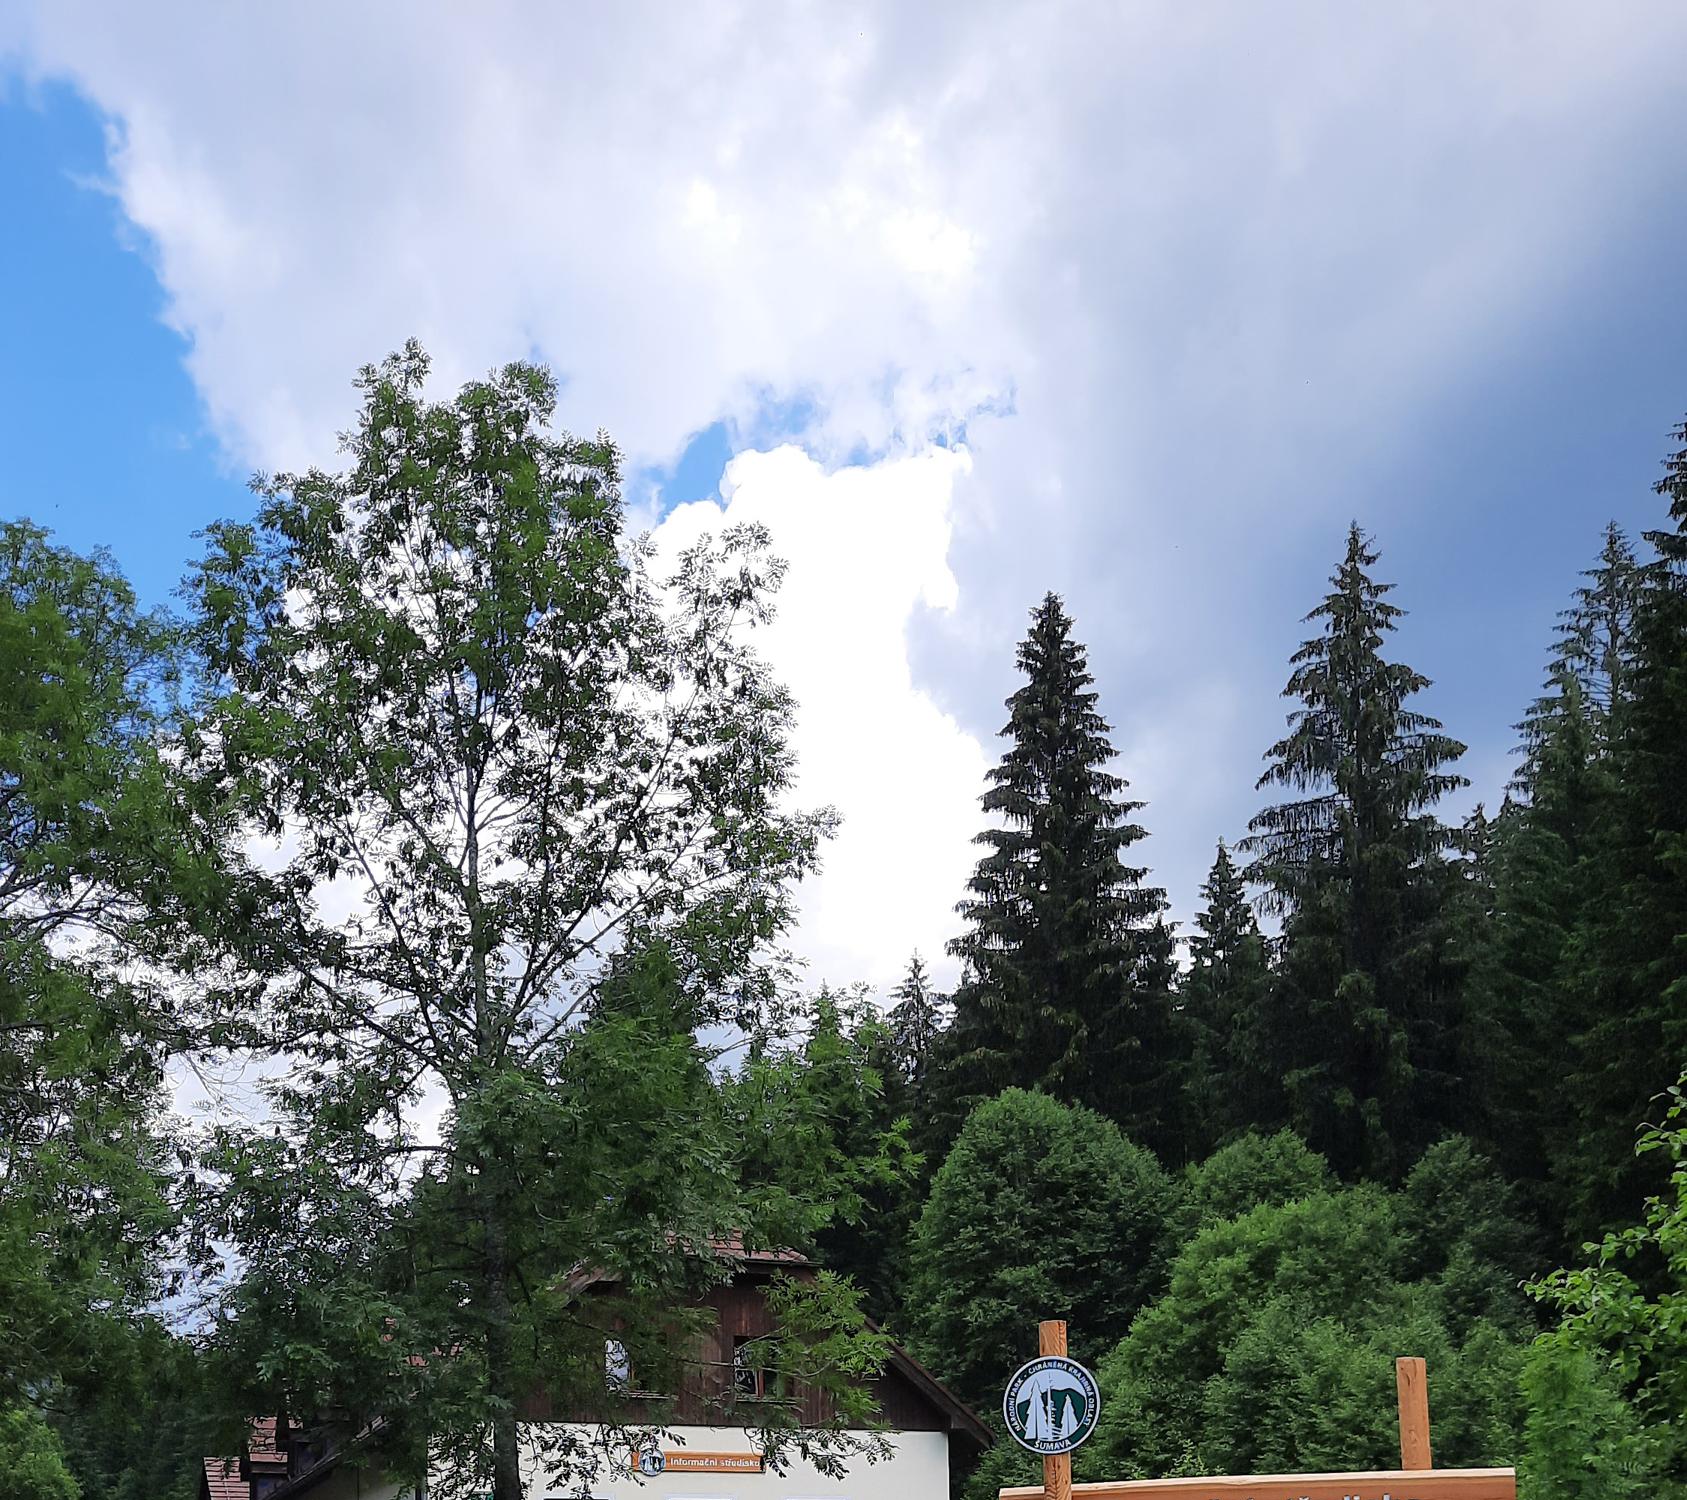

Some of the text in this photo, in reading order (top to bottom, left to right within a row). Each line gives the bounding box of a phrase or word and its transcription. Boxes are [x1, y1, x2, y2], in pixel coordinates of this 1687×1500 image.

[1008, 1378, 1024, 1432] NÁRODNÍ PARK
[1083, 1397, 1095, 1427] OBLAST
[1034, 1439, 1072, 1451] ŠUMAVA
[670, 1456, 718, 1467] Informační
